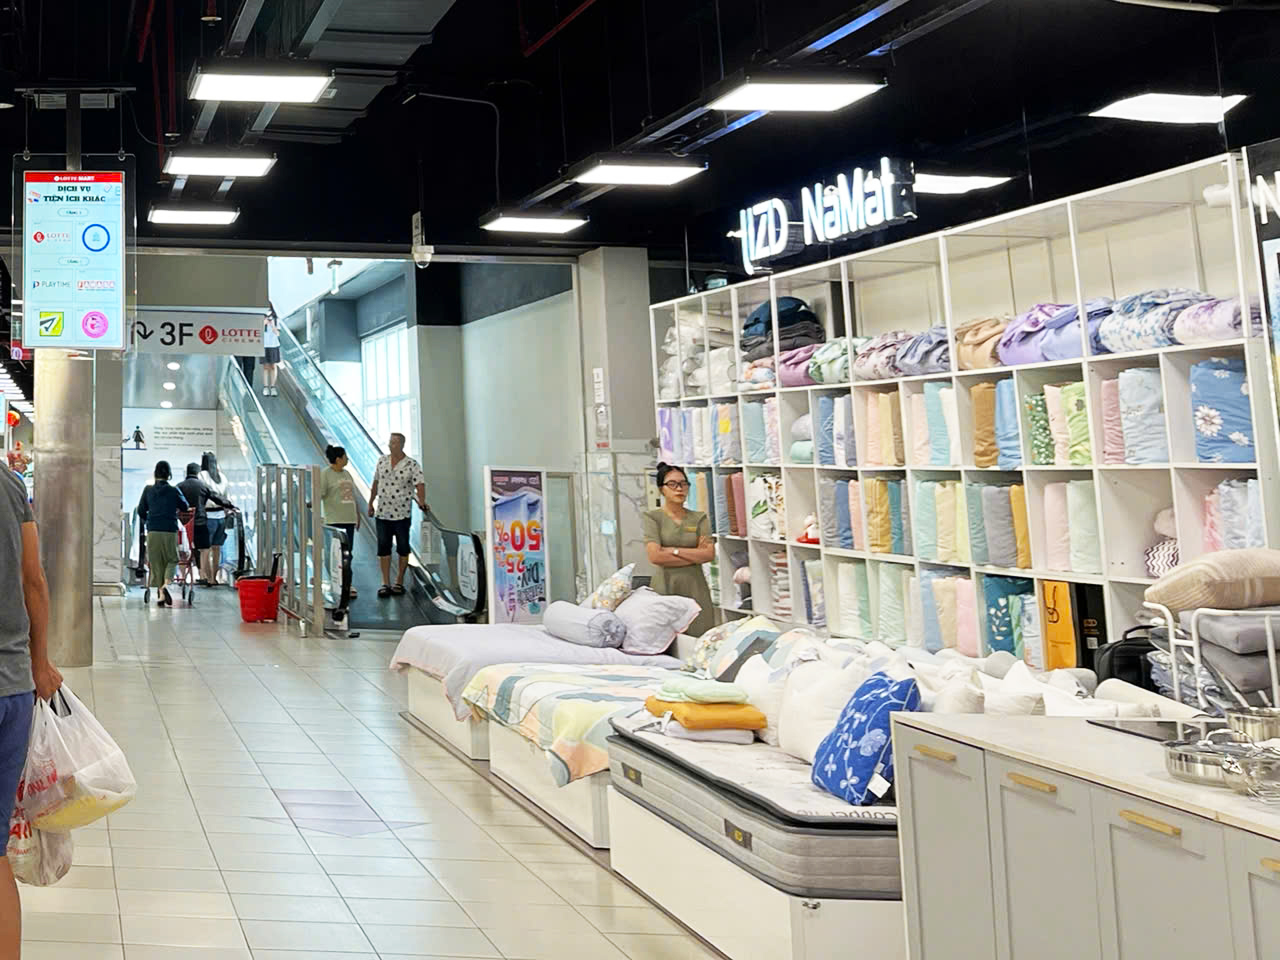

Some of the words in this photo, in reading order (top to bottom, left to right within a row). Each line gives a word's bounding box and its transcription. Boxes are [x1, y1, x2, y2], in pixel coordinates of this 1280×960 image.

[41, 280, 71, 288] PLAYTIME
[159, 321, 194, 346] 3F
[221, 327, 261, 337] LOTTE
